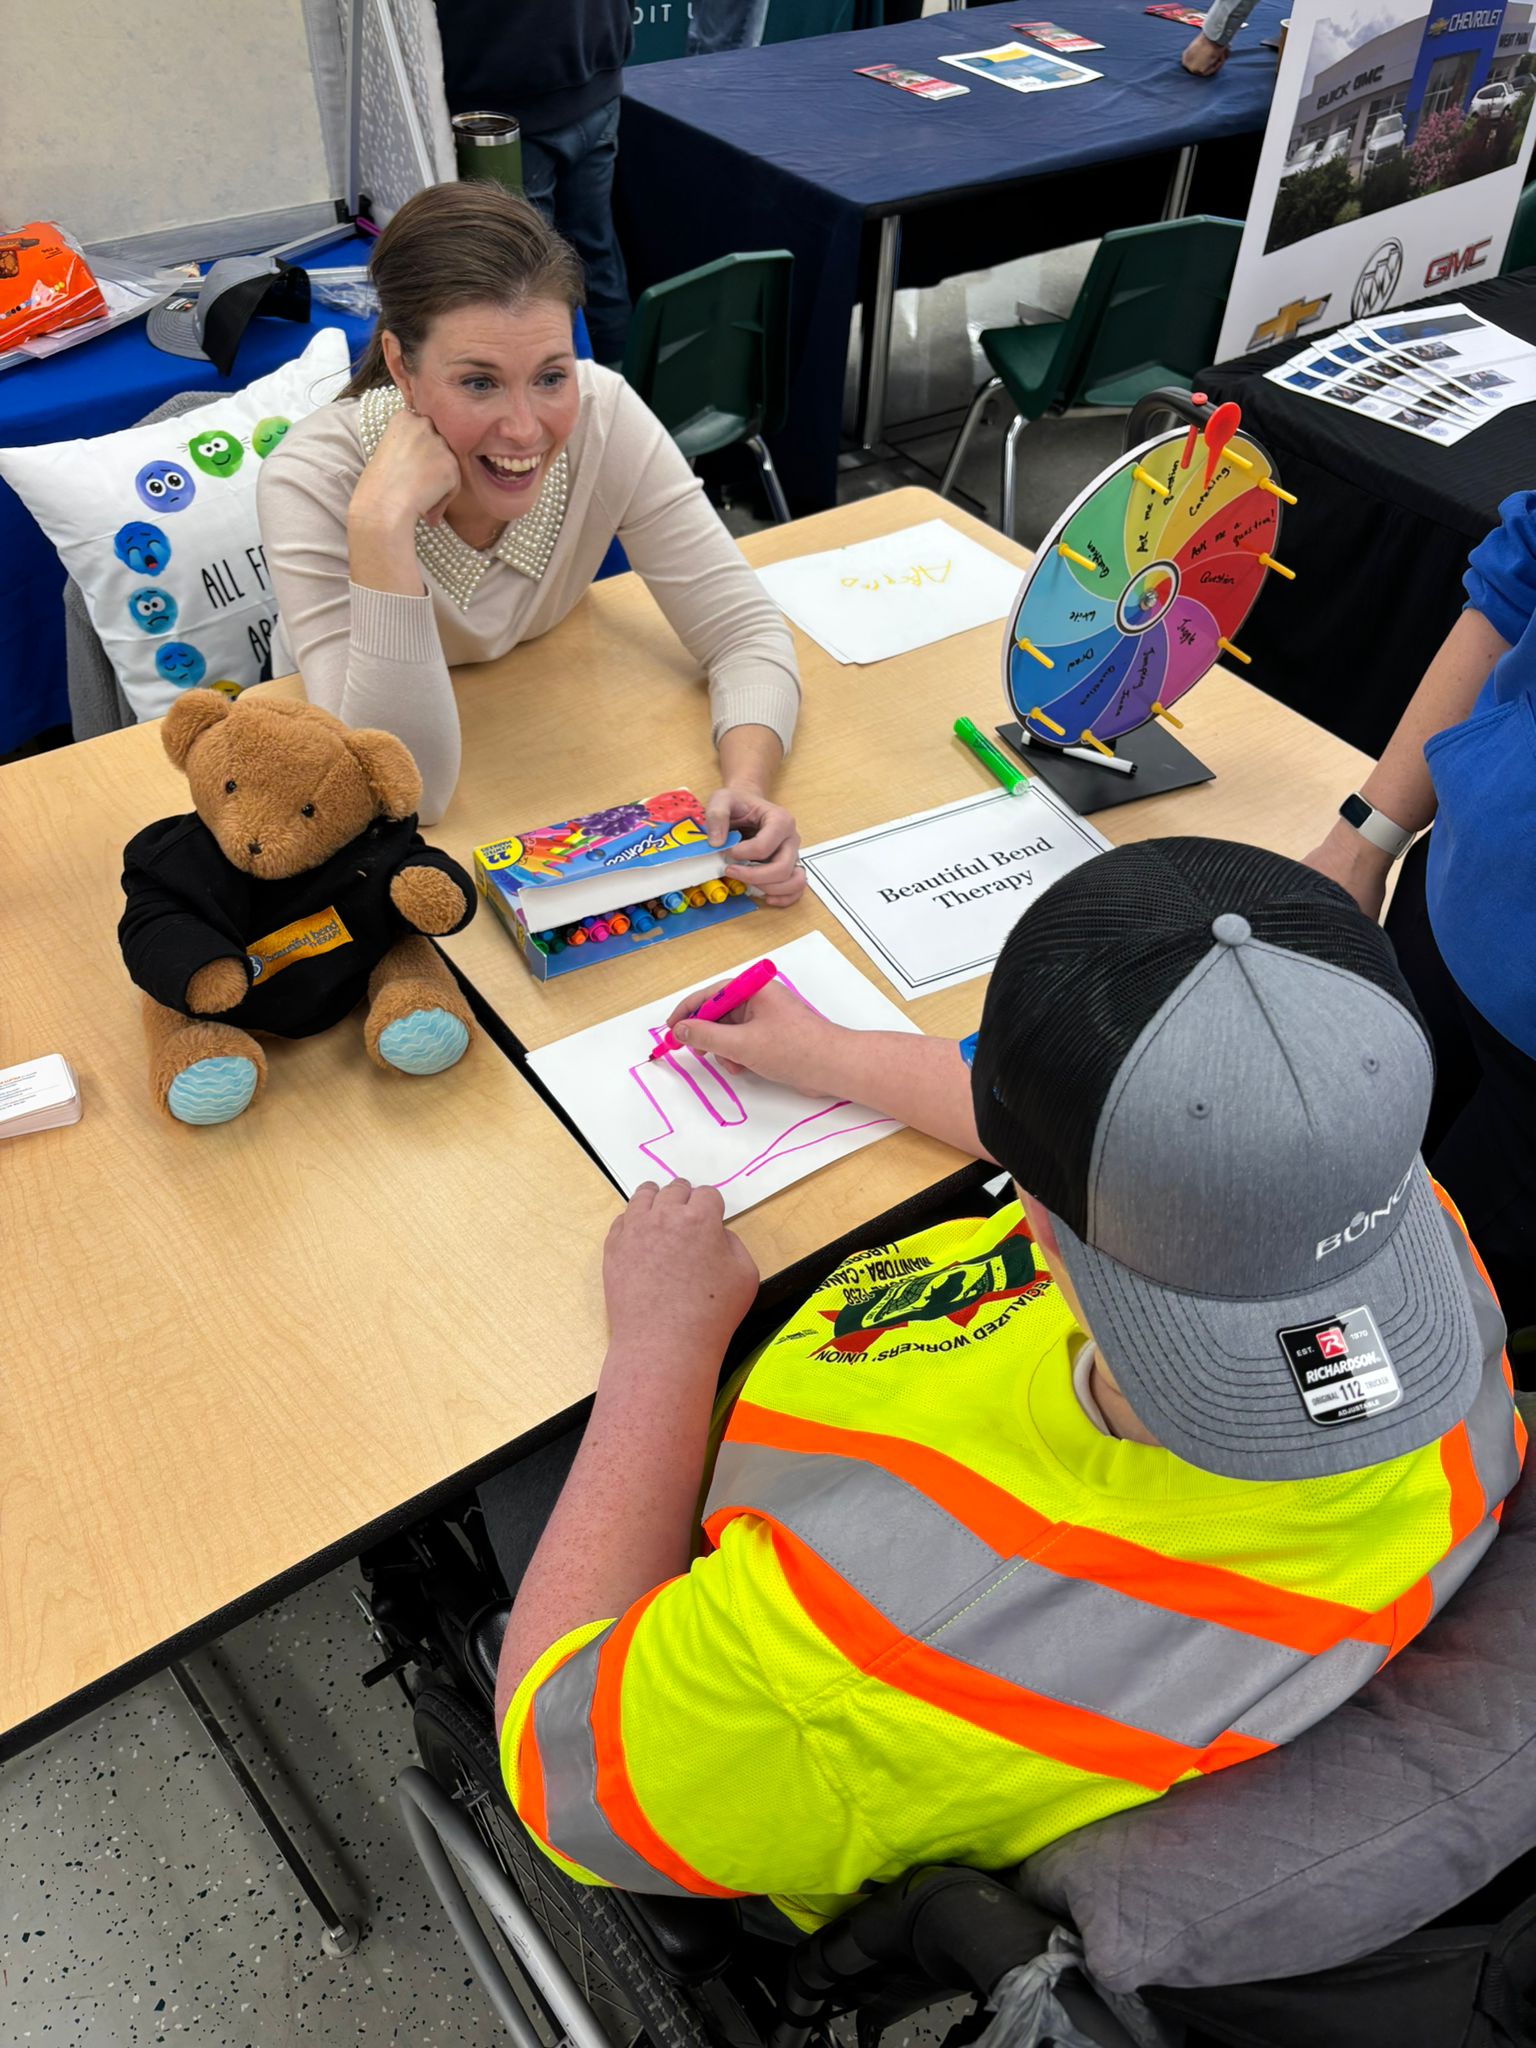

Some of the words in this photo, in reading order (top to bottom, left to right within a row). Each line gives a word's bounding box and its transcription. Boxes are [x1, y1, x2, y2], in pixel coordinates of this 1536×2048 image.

[1448, 9, 1502, 32] CHEVROLET
[1423, 235, 1493, 288] GMC
[201, 558, 246, 609] ALL
[1200, 571, 1235, 584] Question
[877, 857, 991, 904] Beautiful
[989, 836, 1054, 867] Bend
[932, 869, 1035, 910] Therapy
[864, 1256, 933, 1283] MANITOBA
[815, 1350, 869, 1364] UNION
[1305, 1351, 1377, 1384] RICHARDSON
[1339, 1380, 1365, 1401] 112
[1338, 1399, 1380, 1417] ADJUSTABLE
